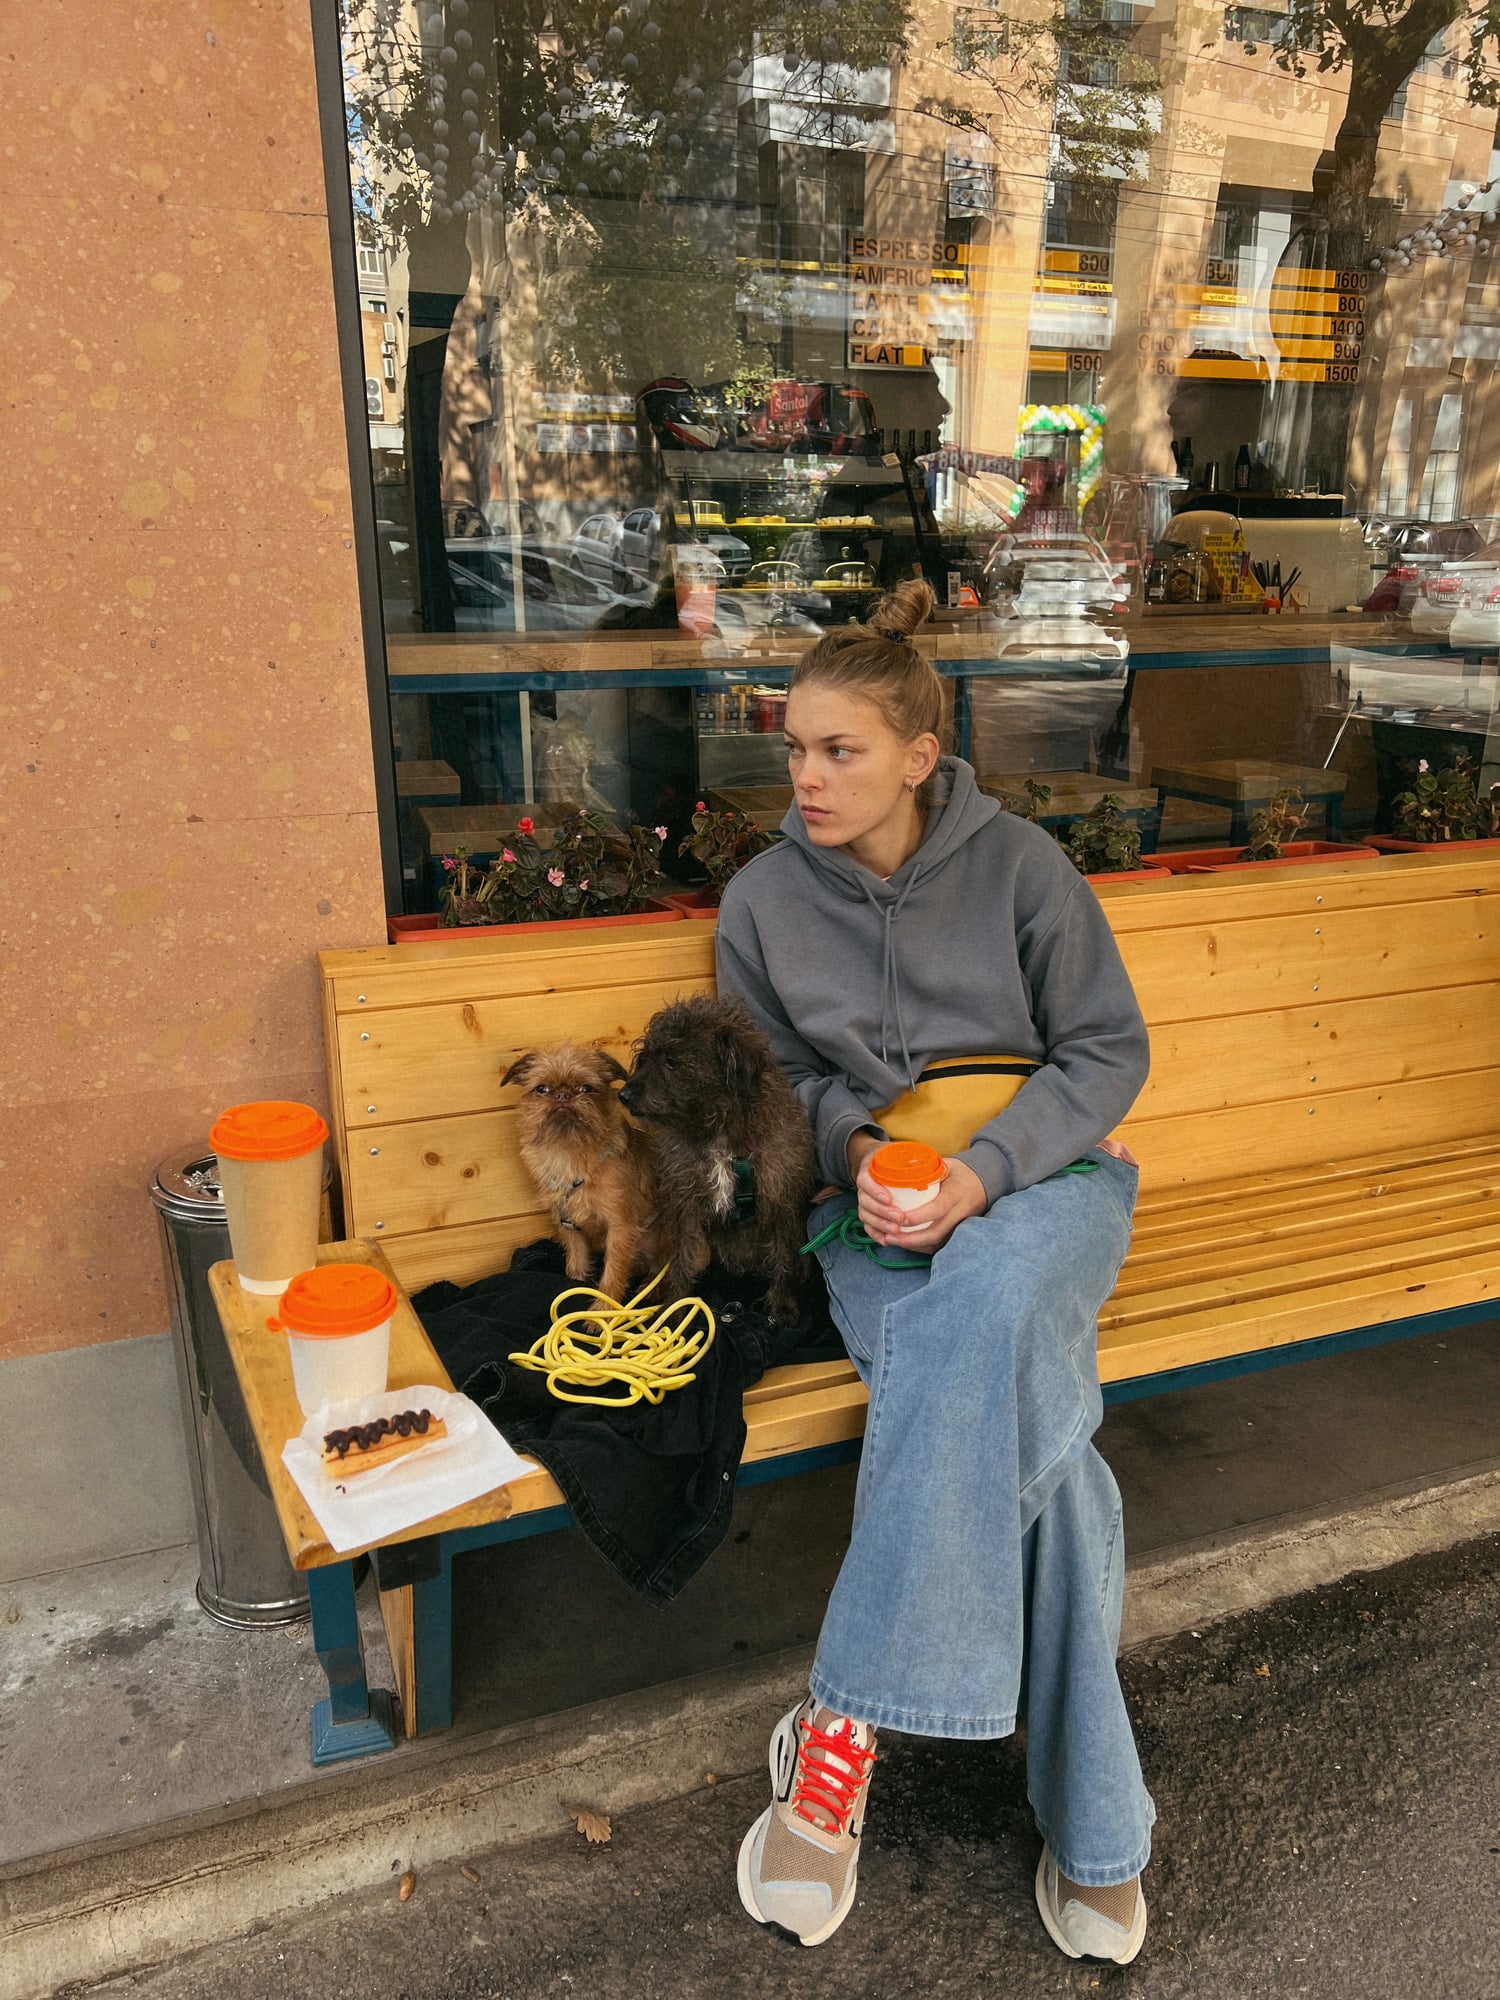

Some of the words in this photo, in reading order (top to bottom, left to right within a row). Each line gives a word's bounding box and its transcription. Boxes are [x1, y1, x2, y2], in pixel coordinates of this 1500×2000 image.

[852, 237, 958, 263] ESPRESSO
[1336, 272, 1368, 289] 1600
[1339, 295, 1365, 313] 800
[1330, 319, 1364, 336] 1400
[851, 344, 903, 364] FLAT
[1067, 354, 1102, 371] 1500
[1334, 343, 1361, 360] 900
[1325, 365, 1358, 382] 1500
[775, 394, 809, 411] Santal
